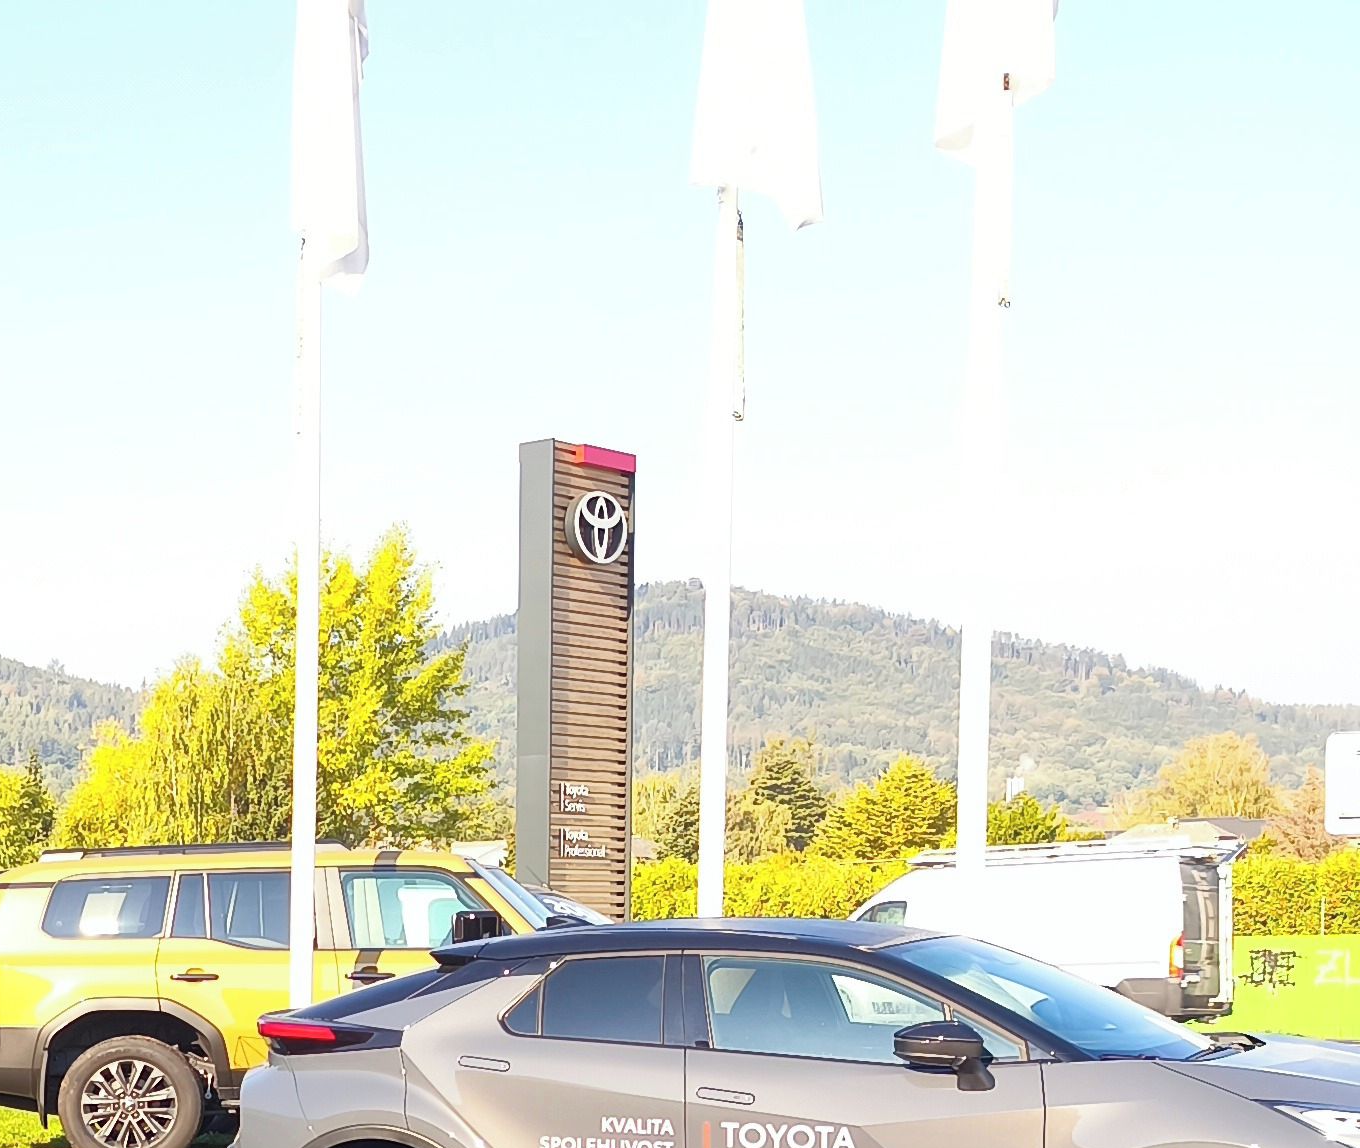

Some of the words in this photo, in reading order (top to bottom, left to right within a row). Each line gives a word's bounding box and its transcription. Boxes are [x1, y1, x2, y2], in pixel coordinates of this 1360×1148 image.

[565, 782, 589, 799] Toyota
[565, 827, 589, 843] Toyota
[600, 1115, 674, 1136] KVALITA
